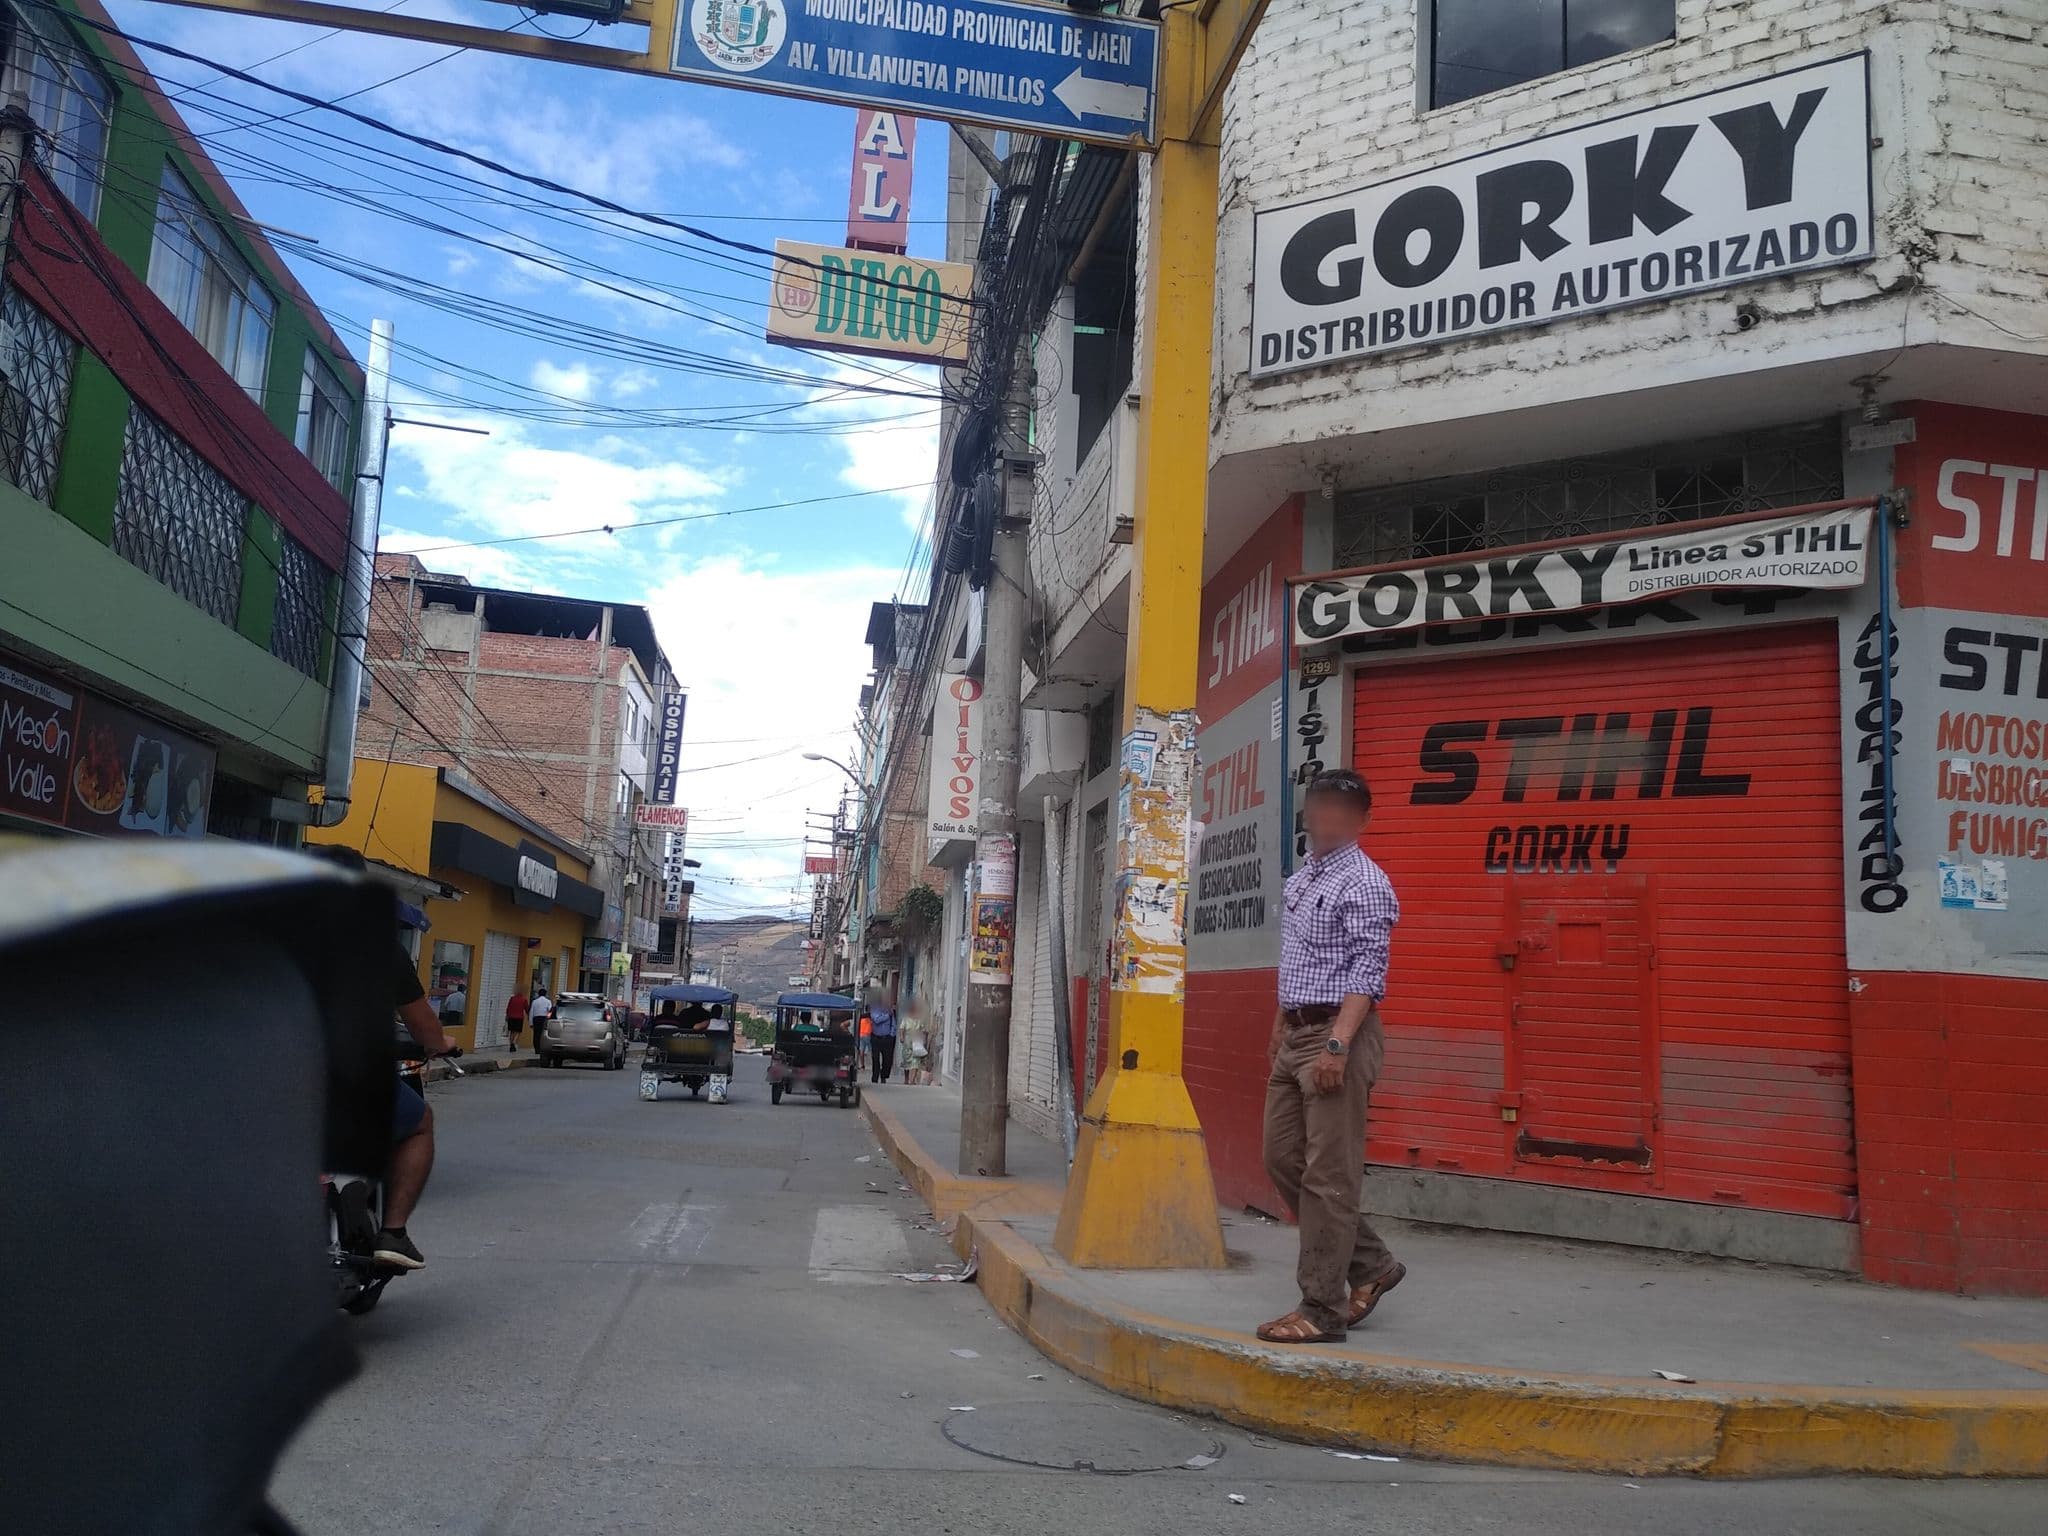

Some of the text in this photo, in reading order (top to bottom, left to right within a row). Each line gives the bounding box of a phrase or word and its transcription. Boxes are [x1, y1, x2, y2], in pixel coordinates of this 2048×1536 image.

[804, 0, 1132, 66] MUNICIPALIDAD PROVINCIAL DE JAEN
[788, 41, 1046, 106] AV. VILLANUEVA PINILLOS
[1280, 86, 1829, 306] GORKY
[815, 254, 942, 346] DIEGO
[1259, 212, 1858, 369] DISTRIBUIDOR AUTORIZADO
[1296, 542, 1624, 640] GORKY
[1629, 544, 1728, 573] Linea
[1740, 522, 1862, 559] STIHL
[1628, 560, 1858, 593] DISTRIBUIDOR AUTORIZADO
[1208, 560, 1275, 689] STIHL
[1303, 661, 1331, 674] 1299
[8, 753, 56, 803] Valle
[657, 694, 682, 801] HOSPEDAJE
[1409, 706, 1752, 805] STIHL
[636, 805, 687, 826] FLAMENCO
[1201, 740, 1266, 826] STIHL
[932, 822, 955, 834] Salón
[1484, 823, 1631, 875] GORKY
[1223, 895, 1266, 932] STRATTON
